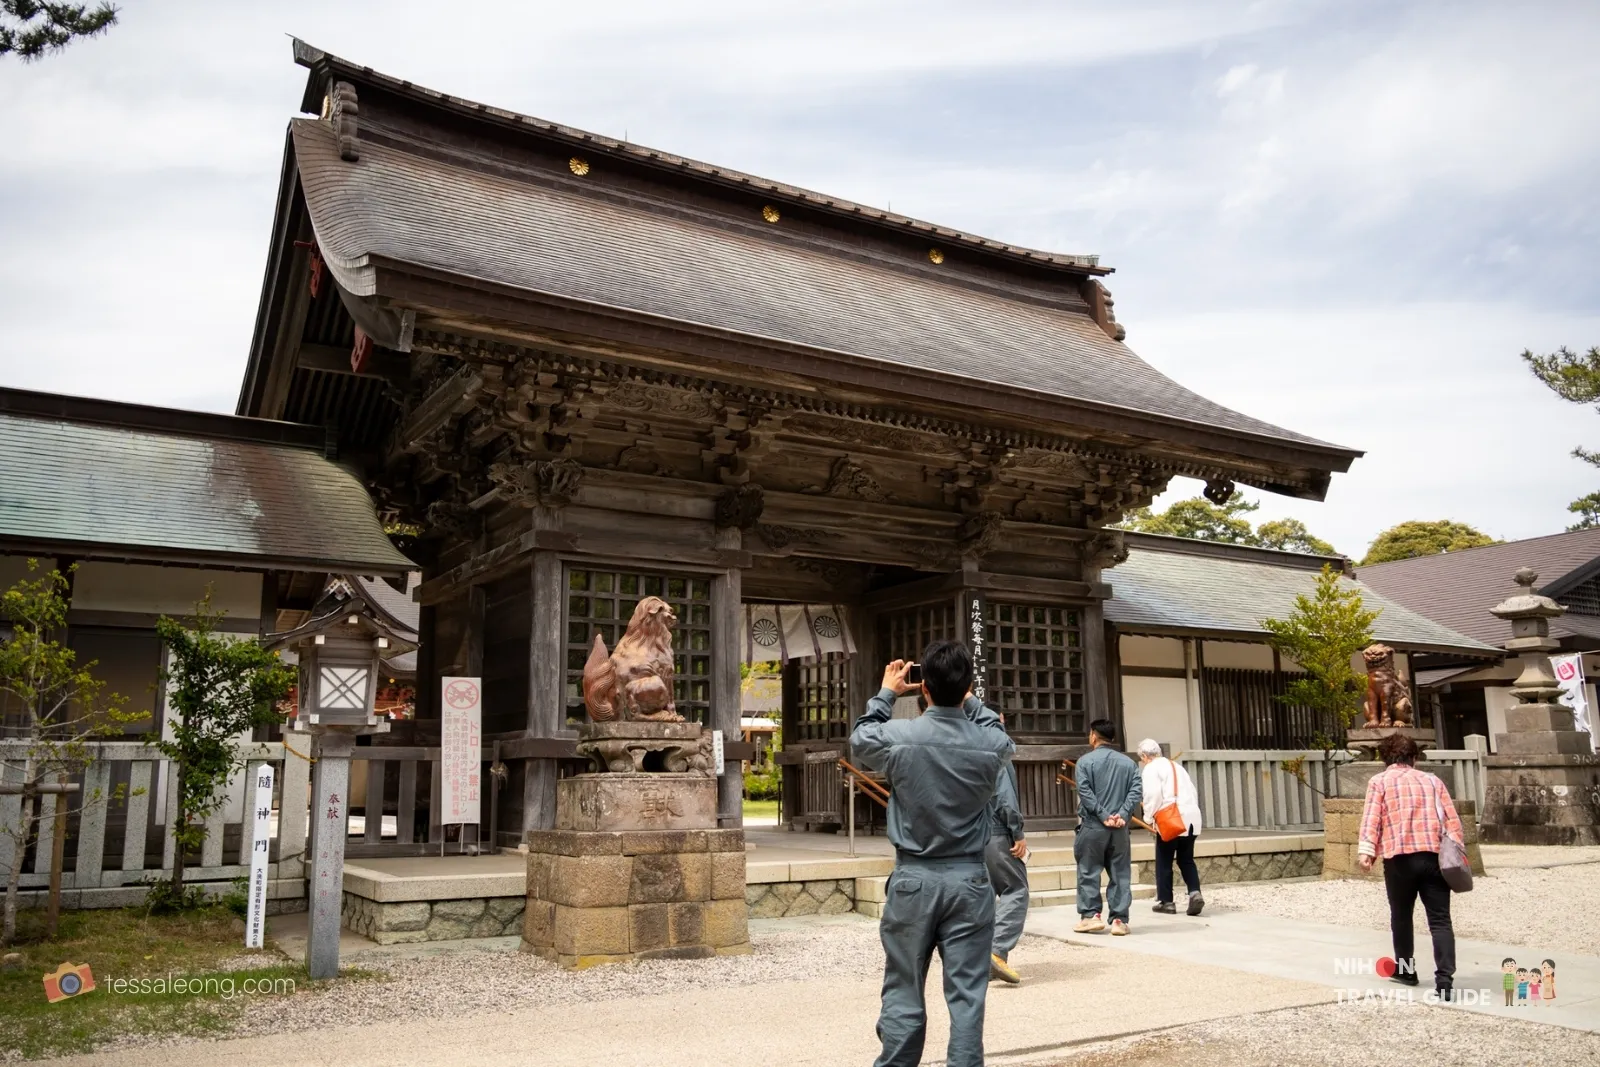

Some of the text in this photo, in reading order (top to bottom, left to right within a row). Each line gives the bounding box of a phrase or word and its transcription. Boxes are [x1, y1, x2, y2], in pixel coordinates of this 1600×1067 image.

[469, 720, 479, 801] ドローン禁止
[326, 793, 341, 820] 奉献
